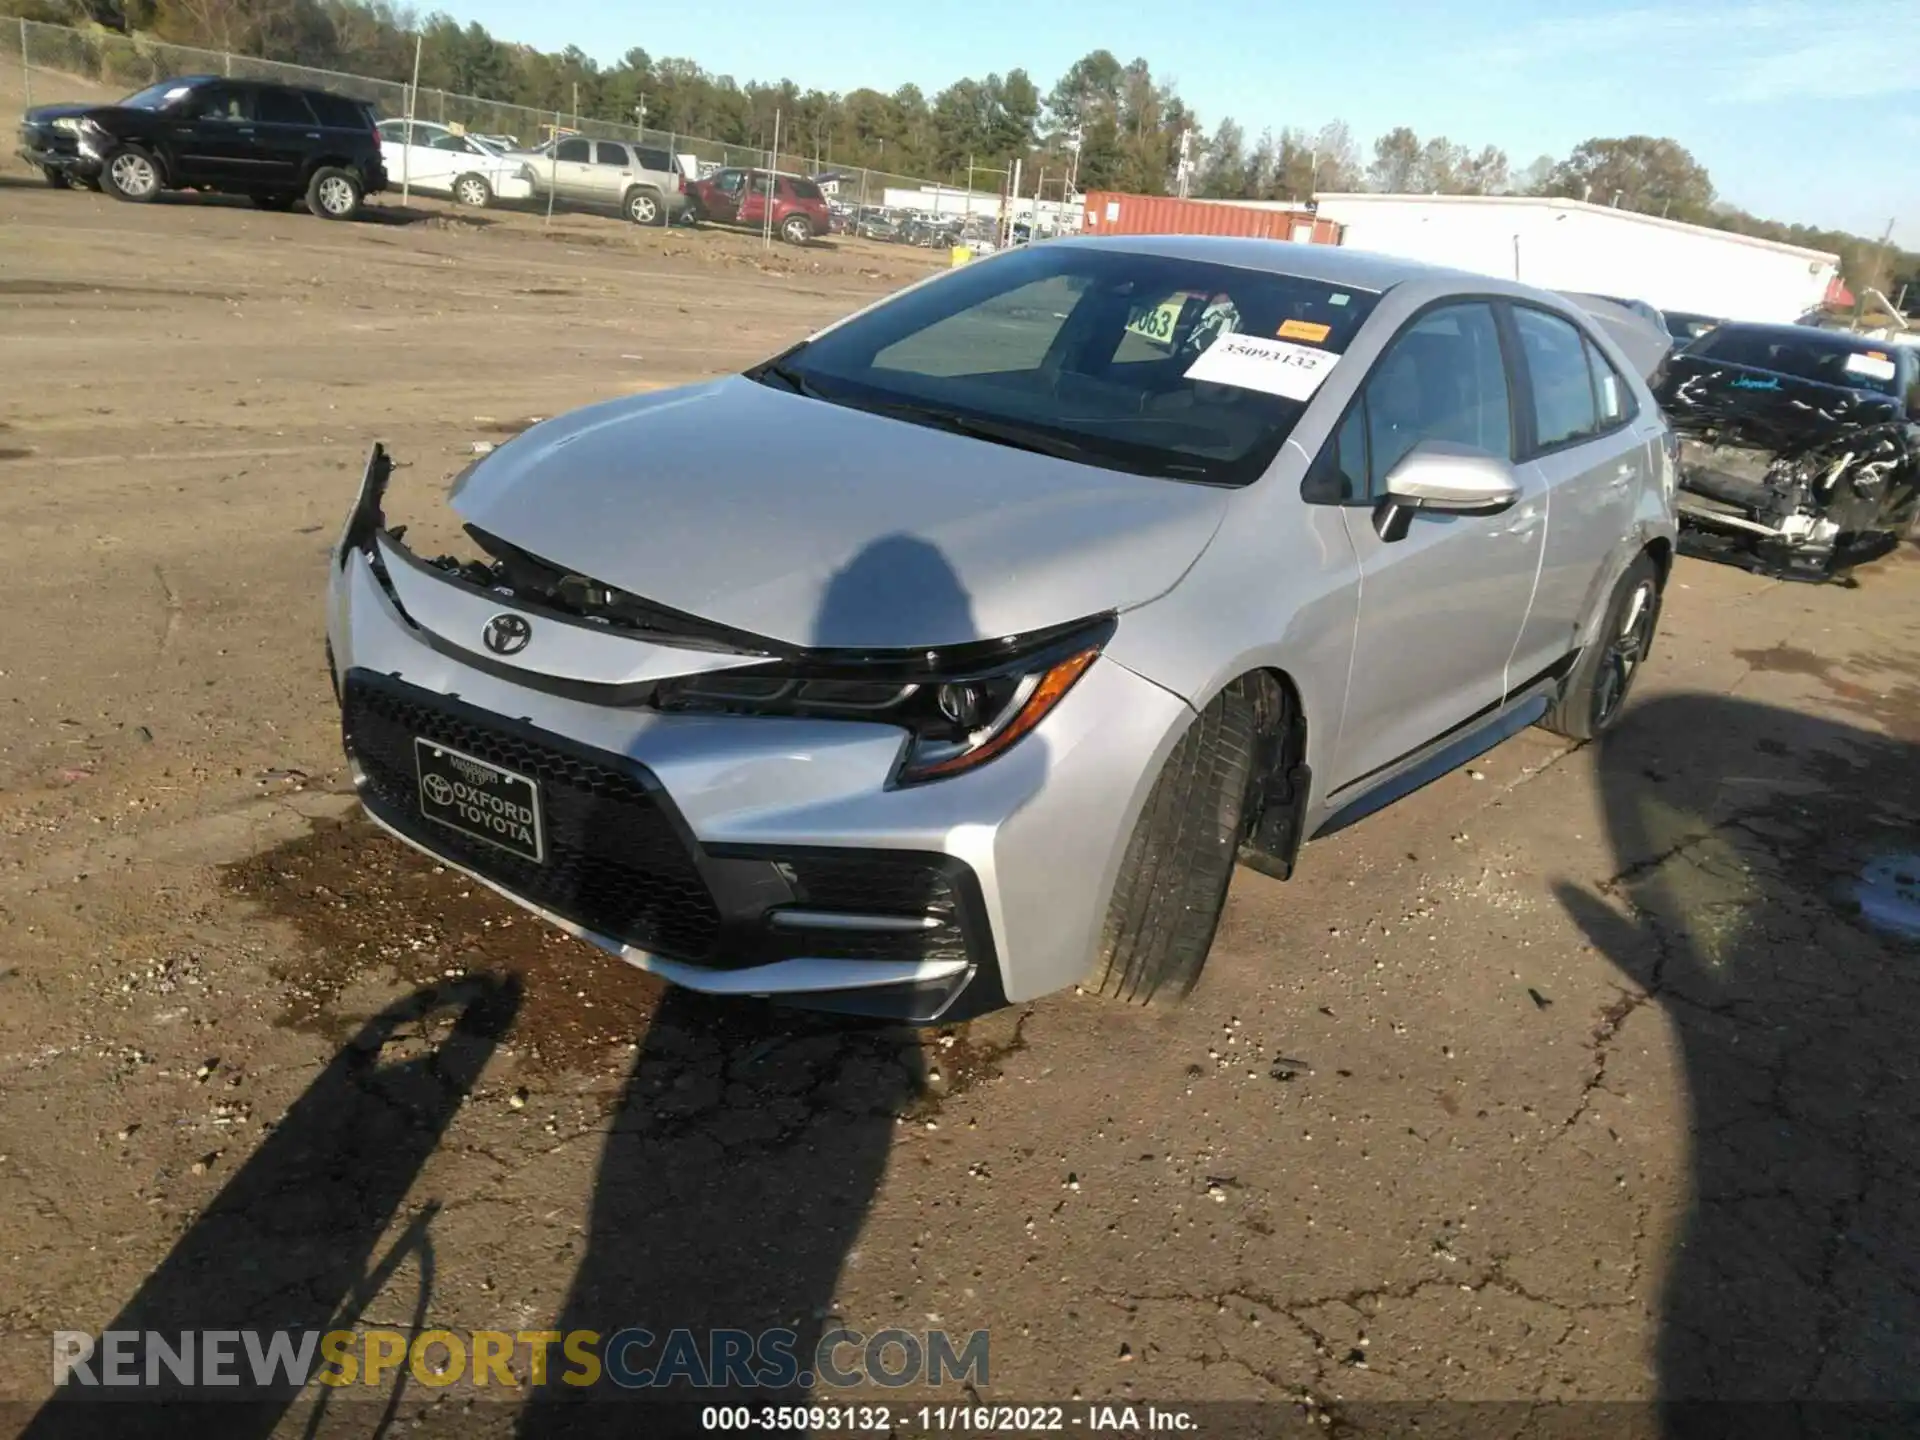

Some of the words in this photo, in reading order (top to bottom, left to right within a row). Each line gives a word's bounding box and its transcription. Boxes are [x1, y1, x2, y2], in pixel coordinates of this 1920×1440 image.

[1128, 309, 1172, 338] 063
[1220, 343, 1317, 370] 35093132
[453, 782, 533, 825] OXFORD
[456, 801, 533, 846] TOYOTA
